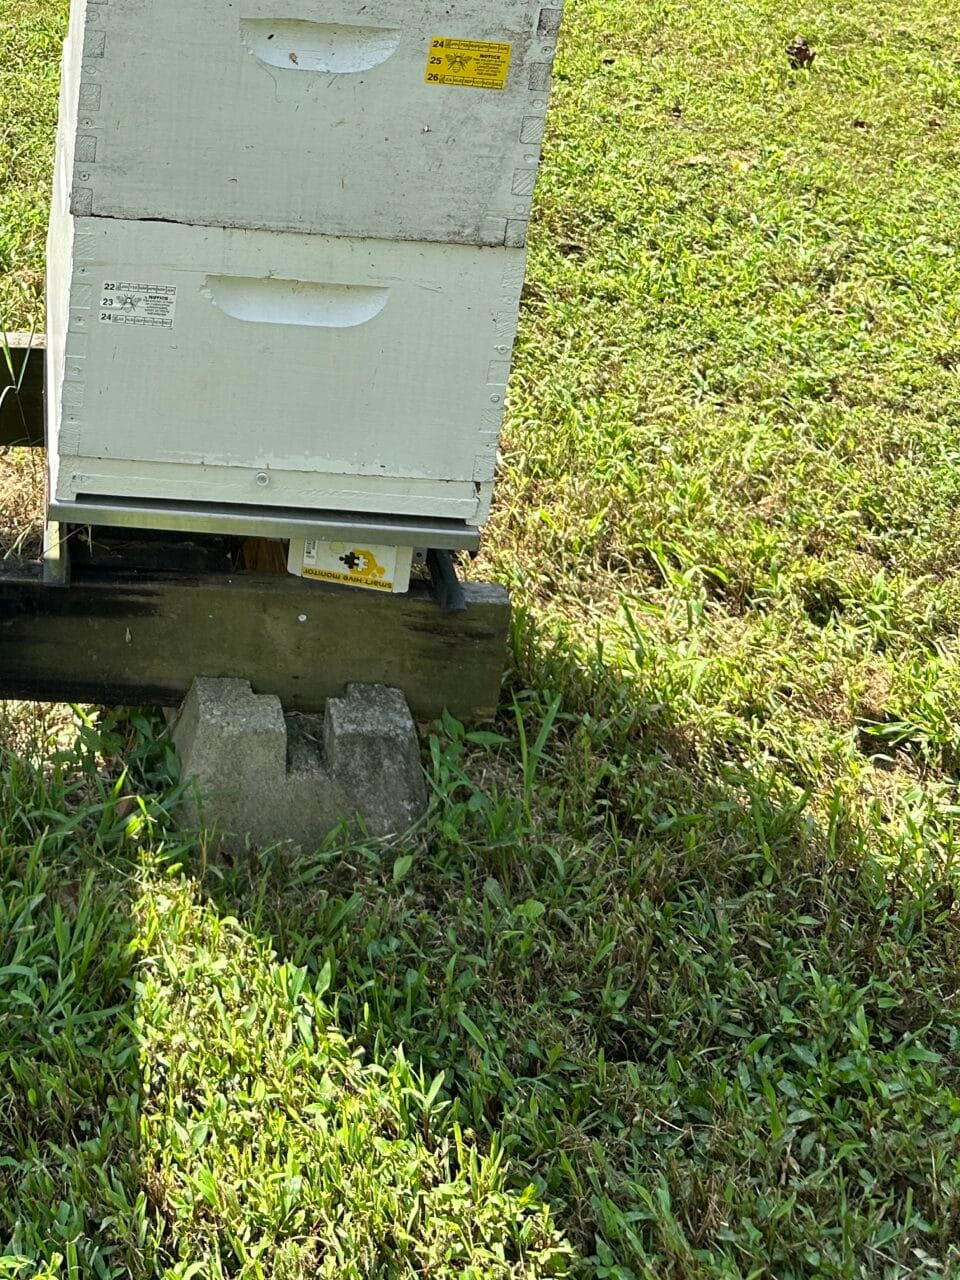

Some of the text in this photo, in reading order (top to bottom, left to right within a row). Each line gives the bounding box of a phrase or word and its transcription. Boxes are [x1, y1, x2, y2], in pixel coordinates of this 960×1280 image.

[432, 40, 444, 48] 24
[430, 56, 442, 65] 25
[427, 73, 439, 81] 26
[104, 283, 115, 291] 22
[102, 298, 113, 306] 23
[101, 313, 112, 321] 24
